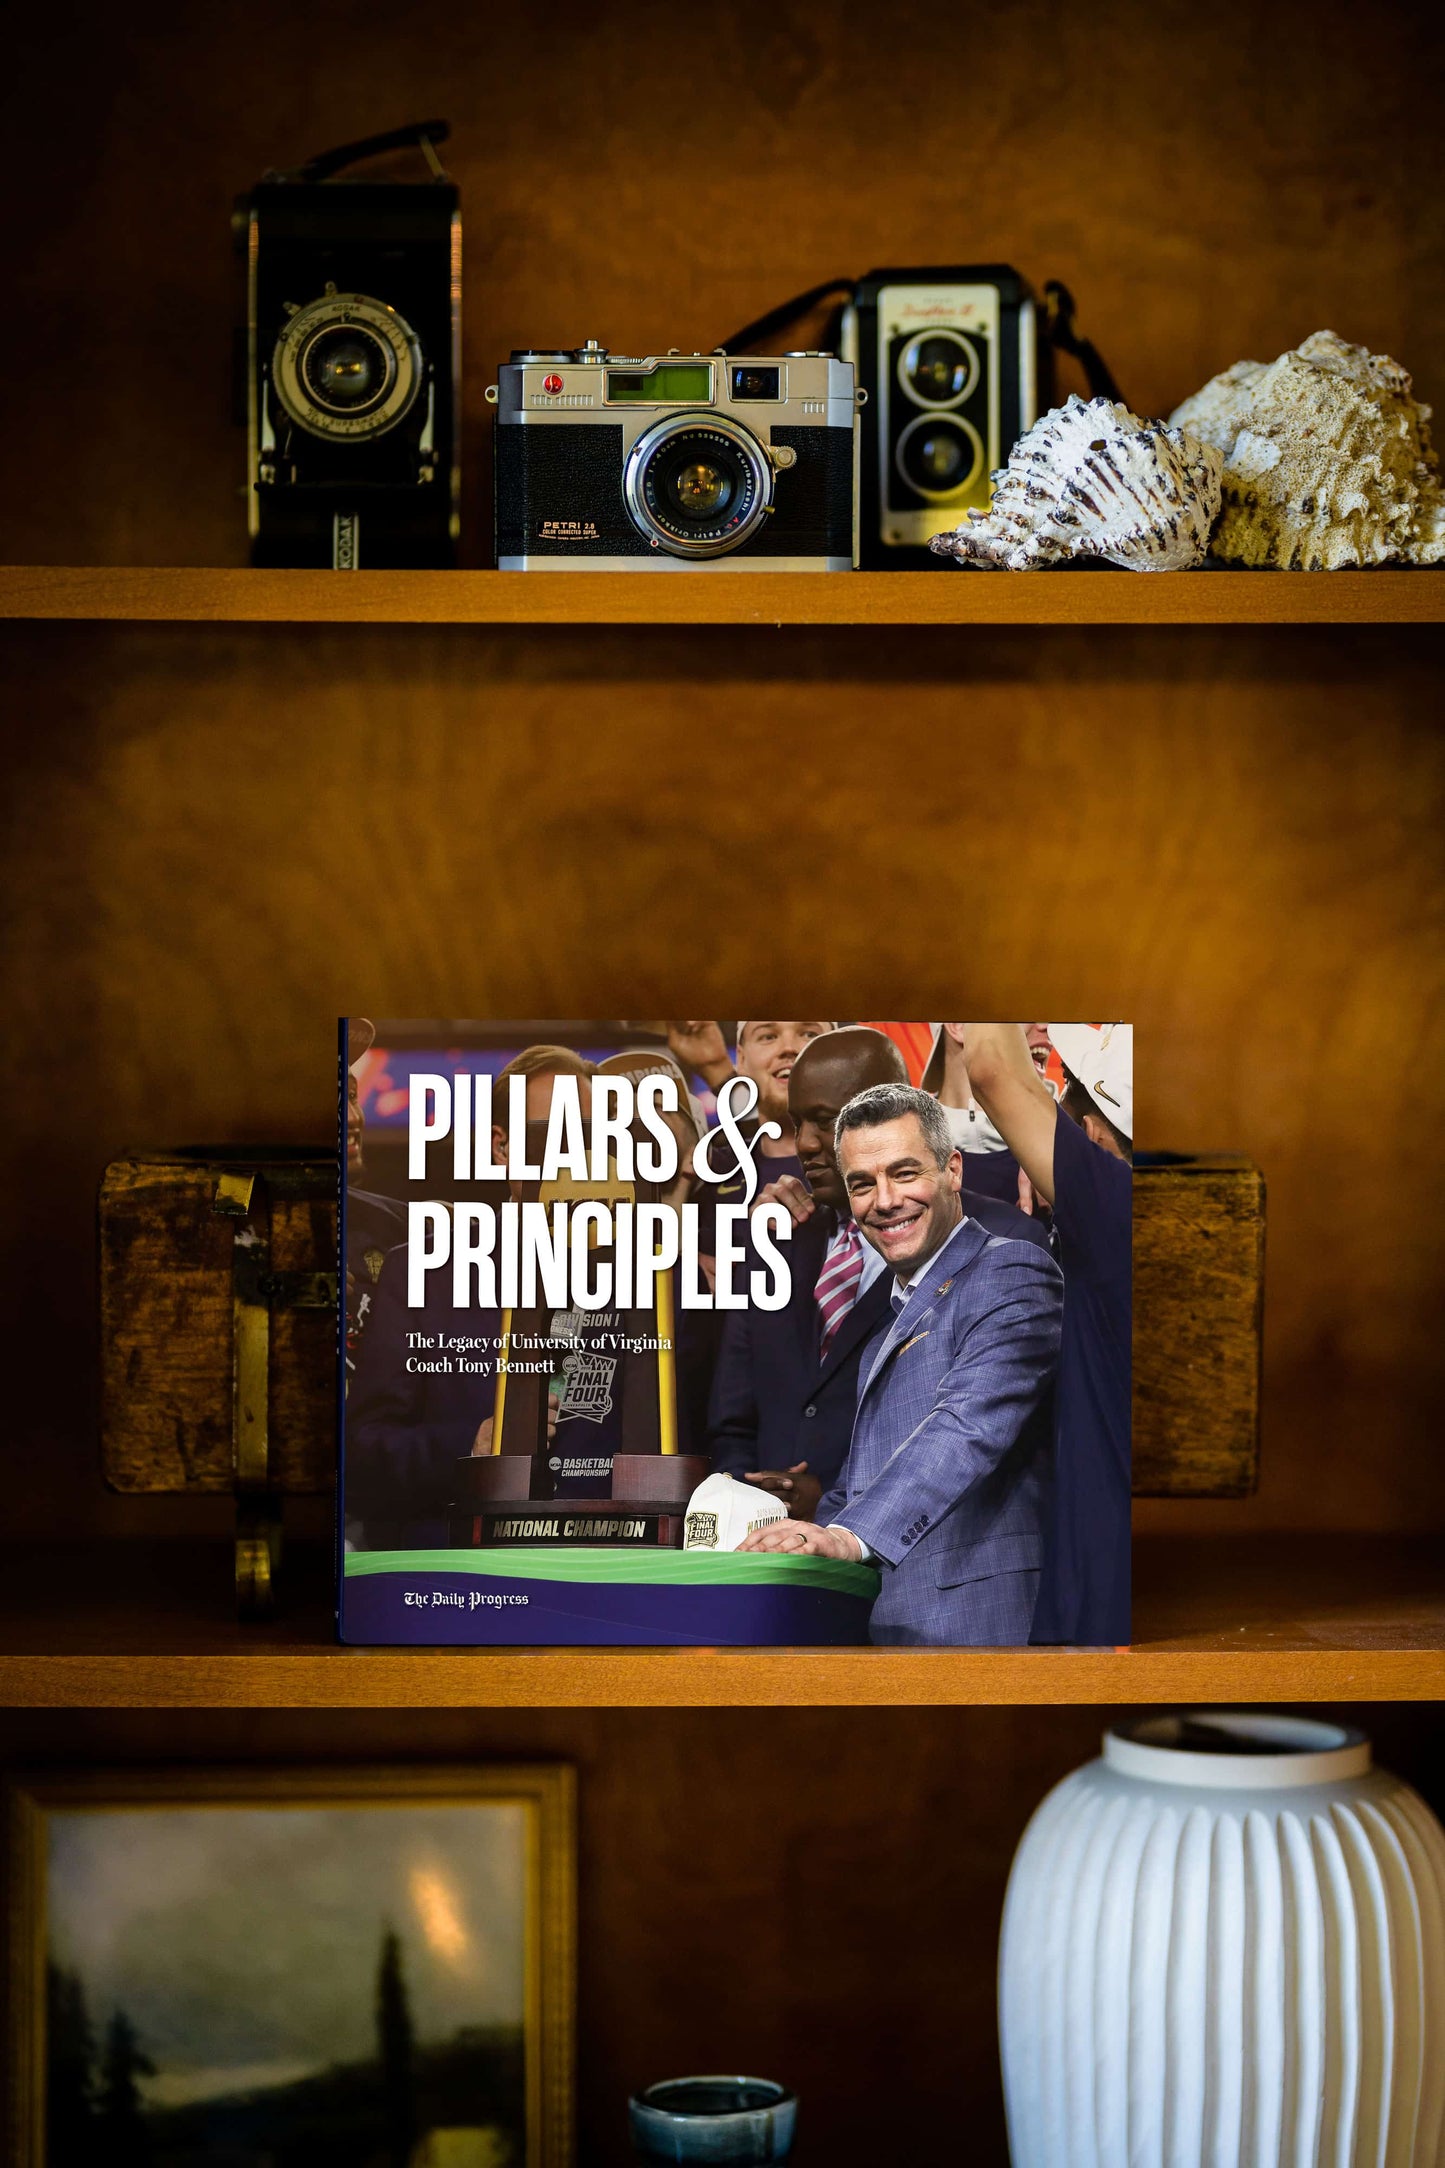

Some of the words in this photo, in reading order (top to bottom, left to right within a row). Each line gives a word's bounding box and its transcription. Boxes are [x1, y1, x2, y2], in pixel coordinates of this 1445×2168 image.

[543, 521, 581, 529] PETRI
[693, 528, 721, 540] Petri
[408, 1073, 679, 1183] PILLARS
[692, 1075, 783, 1204] &
[407, 1201, 792, 1311] PRINCIPLES
[406, 1332, 435, 1350] The
[437, 1332, 490, 1353] Legacy
[491, 1332, 508, 1350] of
[511, 1332, 589, 1353] University
[591, 1332, 609, 1350] of
[609, 1332, 672, 1354] Virginia
[406, 1356, 452, 1373] Coach
[455, 1356, 493, 1377] Tony
[495, 1356, 556, 1374] Bennett
[567, 1371, 609, 1386] FINAL
[563, 1387, 608, 1403] FOUR
[562, 1458, 614, 1469] BASKETBAL
[561, 1469, 610, 1477] CHAMPIONSHIP
[492, 1520, 560, 1538] NATIONAL
[563, 1520, 647, 1538] CHAMPION
[689, 1529, 714, 1538] FOUR
[691, 1521, 715, 1531] FINAL
[403, 1592, 428, 1608] The
[431, 1592, 465, 1608] Daily
[468, 1591, 529, 1611] Progress
